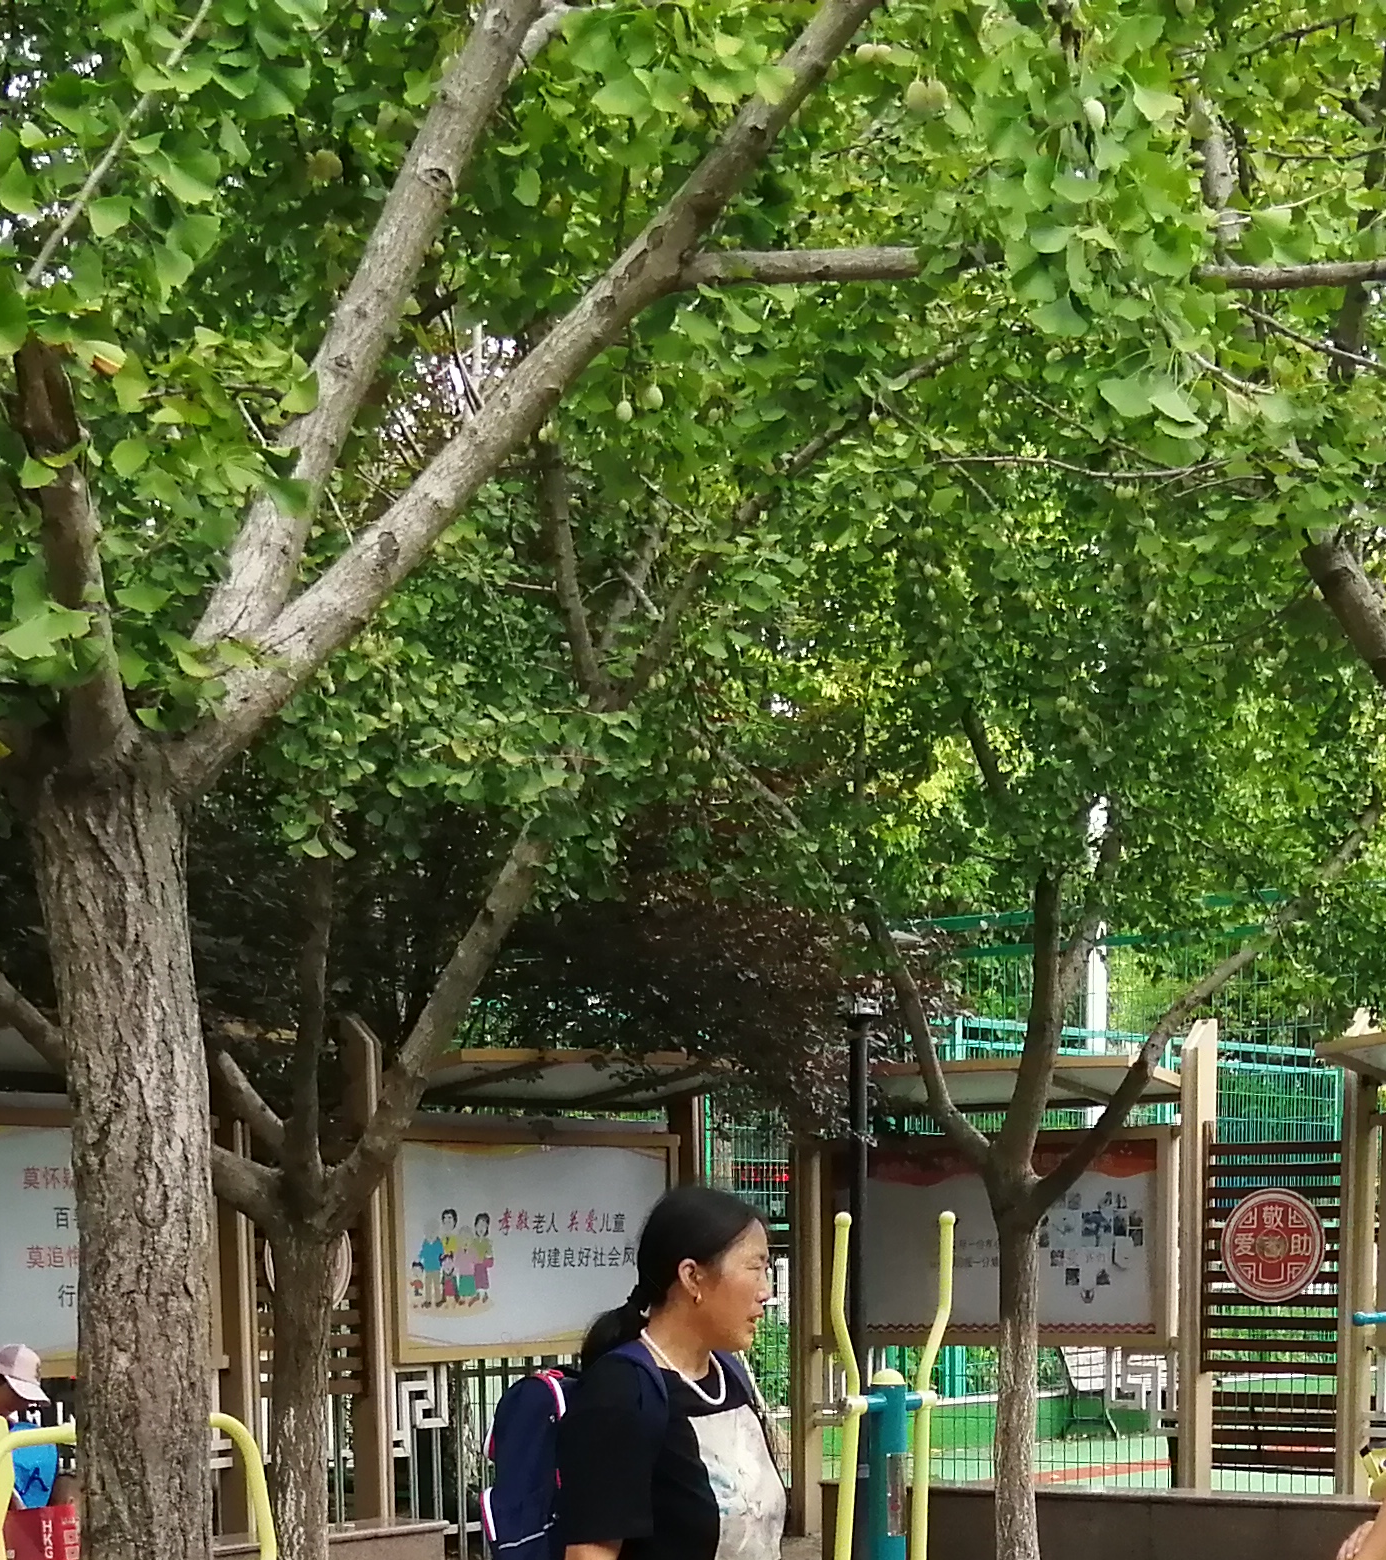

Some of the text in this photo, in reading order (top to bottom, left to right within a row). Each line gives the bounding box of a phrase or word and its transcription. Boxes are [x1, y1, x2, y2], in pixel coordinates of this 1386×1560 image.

[53, 1206, 78, 1229] 百
[498, 1207, 626, 1236] 孝敬老人 关爱儿童
[1262, 1205, 1284, 1229] 敬
[531, 1247, 636, 1268] 构建良好社会风
[58, 1284, 76, 1308] 行
[42, 1519, 54, 1559] HKG
